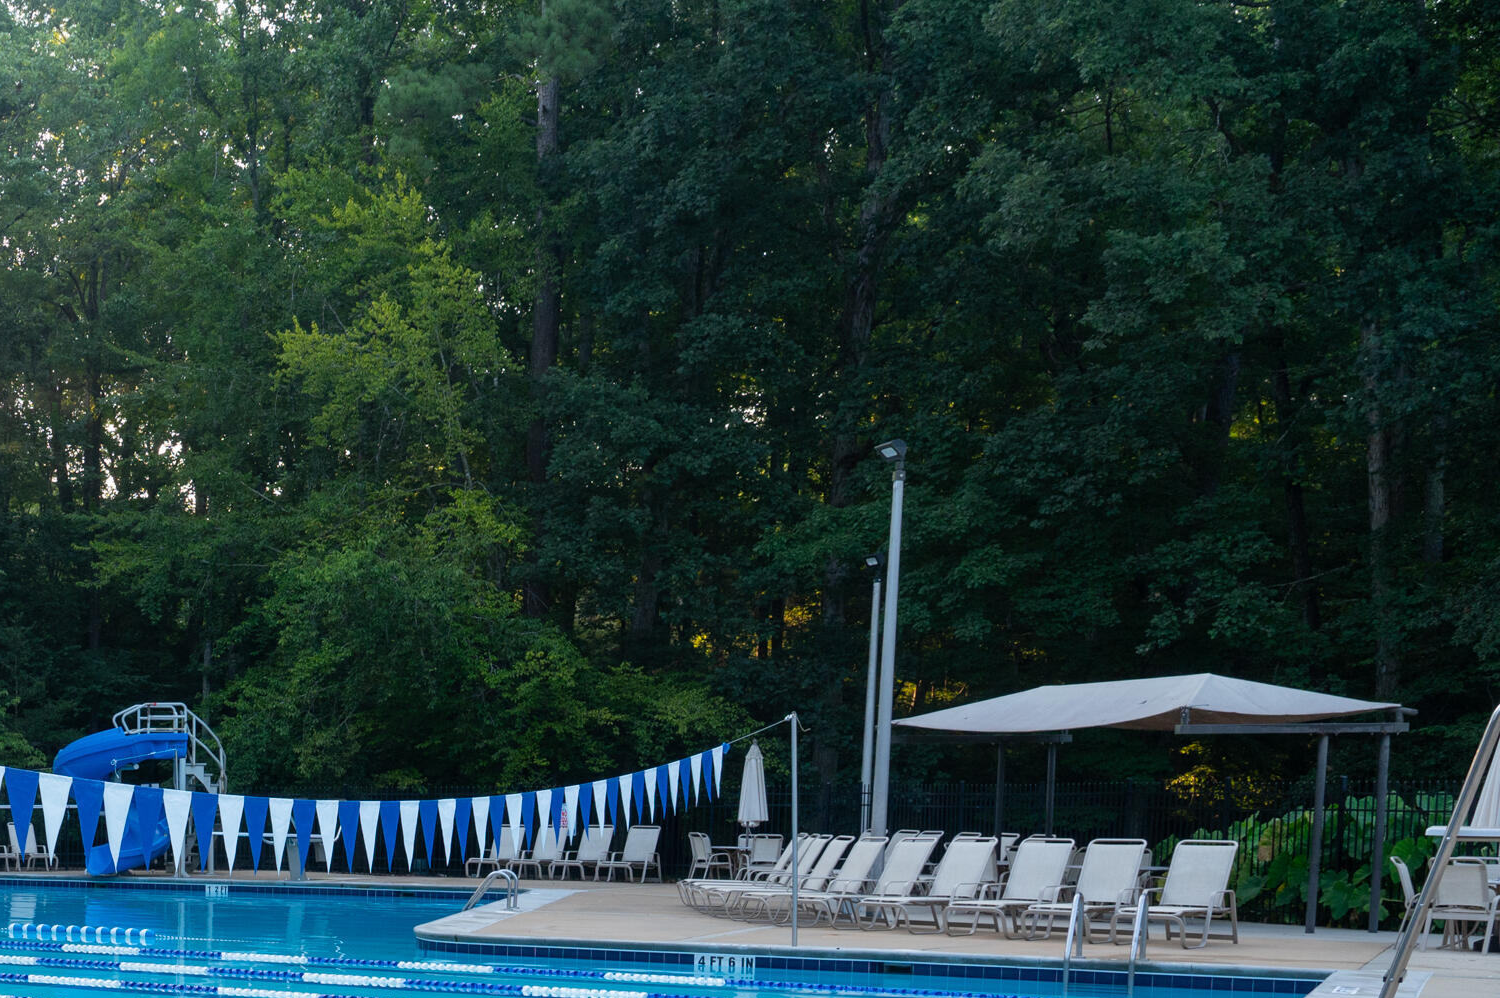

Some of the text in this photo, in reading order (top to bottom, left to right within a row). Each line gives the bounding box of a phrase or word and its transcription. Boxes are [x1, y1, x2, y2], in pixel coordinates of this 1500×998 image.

[698, 955, 754, 969] 4 FT 6 IN
